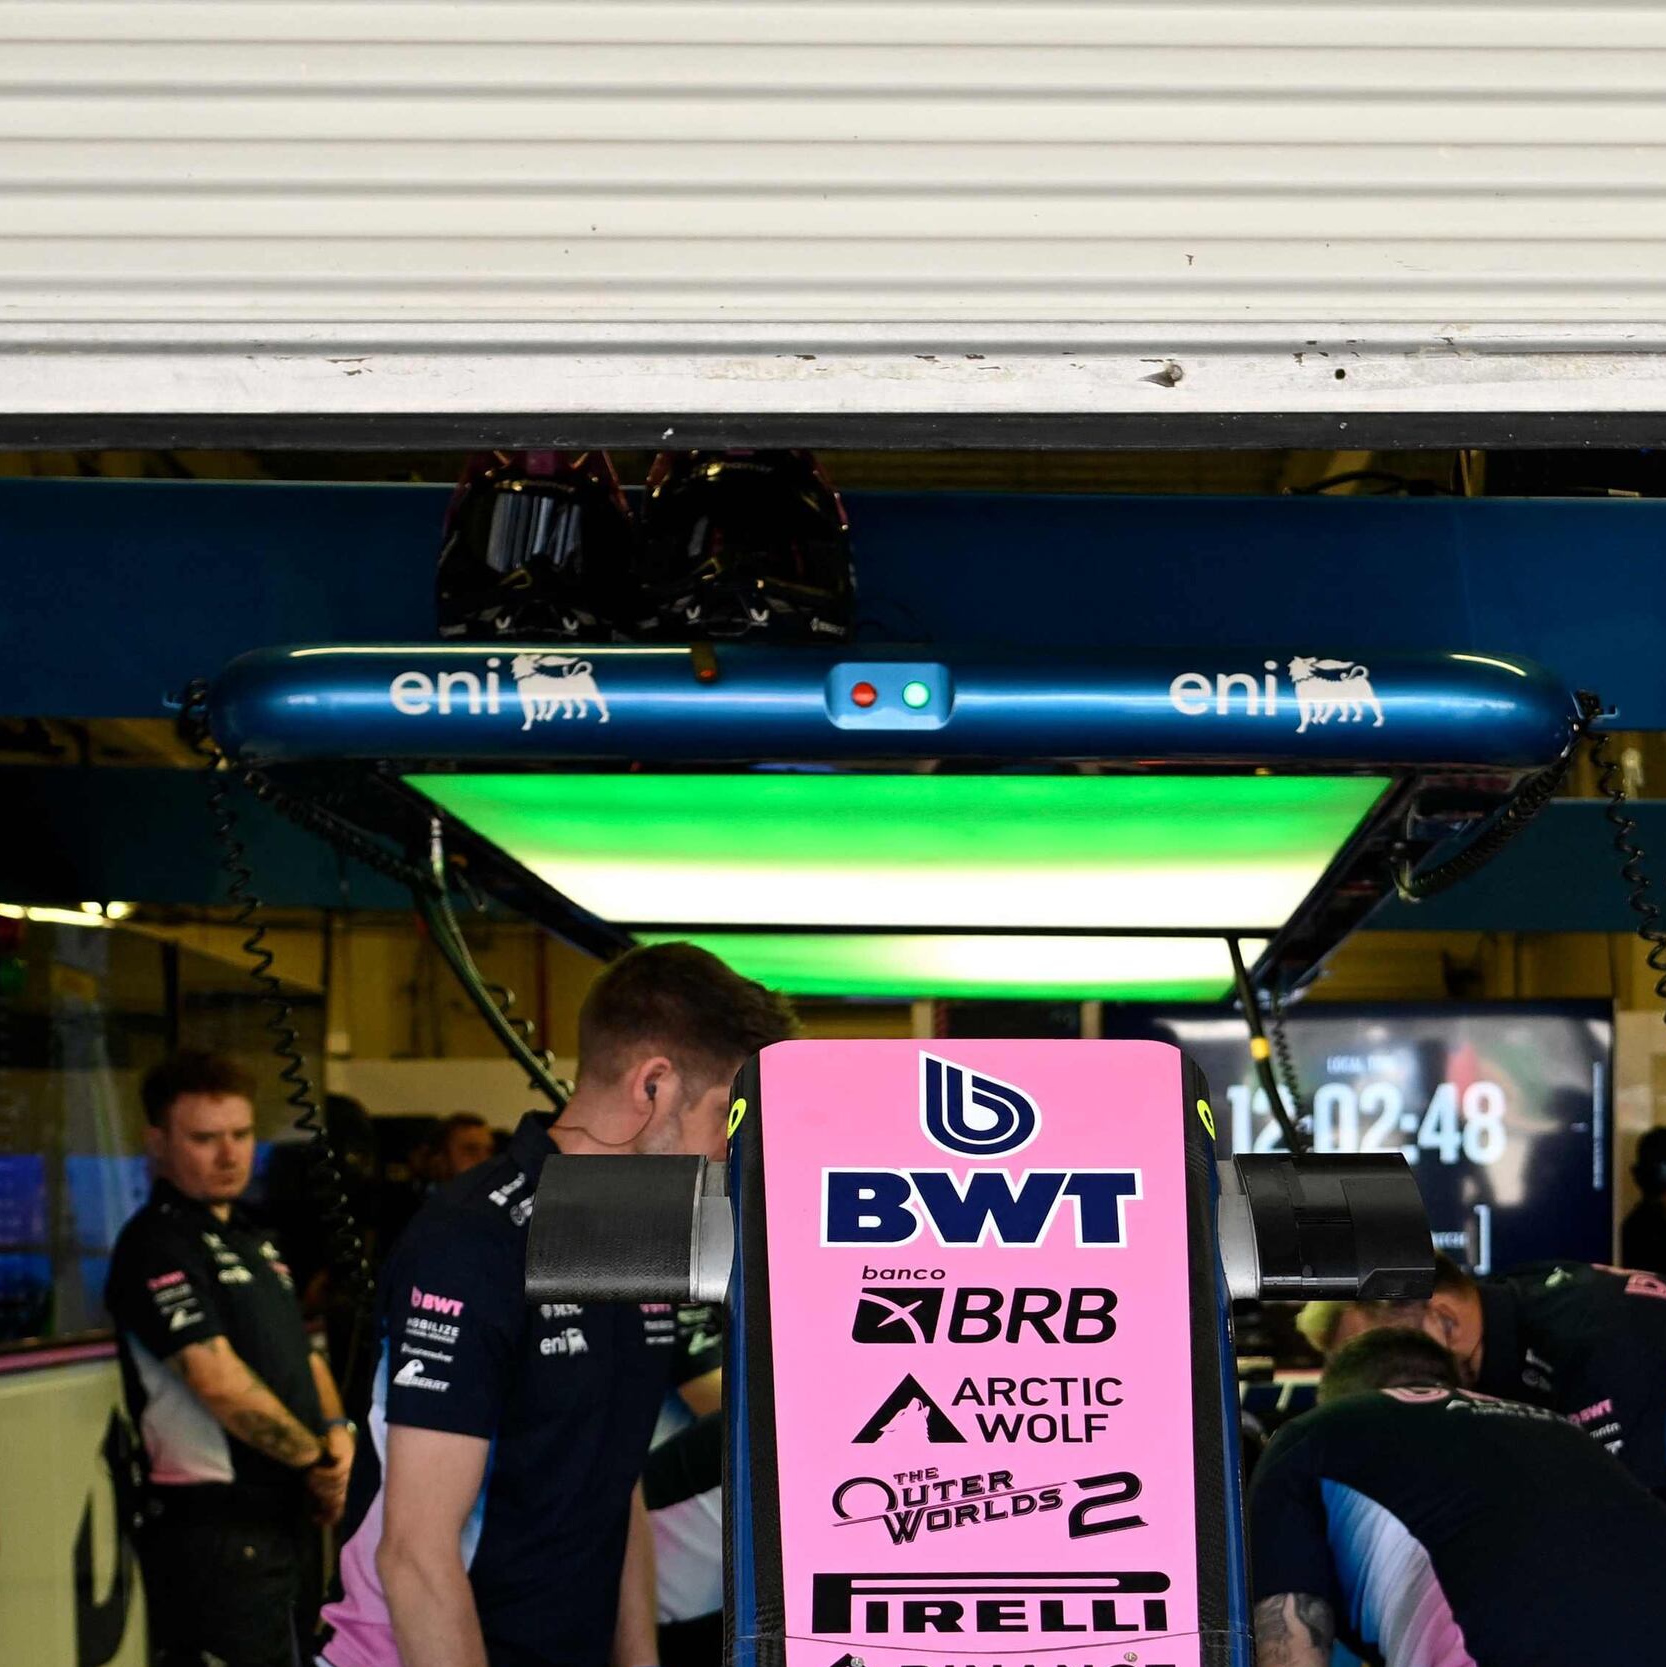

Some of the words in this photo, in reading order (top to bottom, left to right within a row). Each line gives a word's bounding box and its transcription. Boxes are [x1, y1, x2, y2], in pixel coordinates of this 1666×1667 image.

[390, 659, 499, 715] eni
[1169, 661, 1277, 716] eni
[820, 1167, 1144, 1249] BWT
[861, 1265, 946, 1280] banco
[946, 1287, 1118, 1344] BRB
[951, 1377, 1123, 1407] ARCTIC
[973, 1413, 1110, 1444] WOLF
[893, 1466, 939, 1485] THE
[881, 1487, 1064, 1546] WORLDS
[812, 1571, 1171, 1634] PIRELLI
